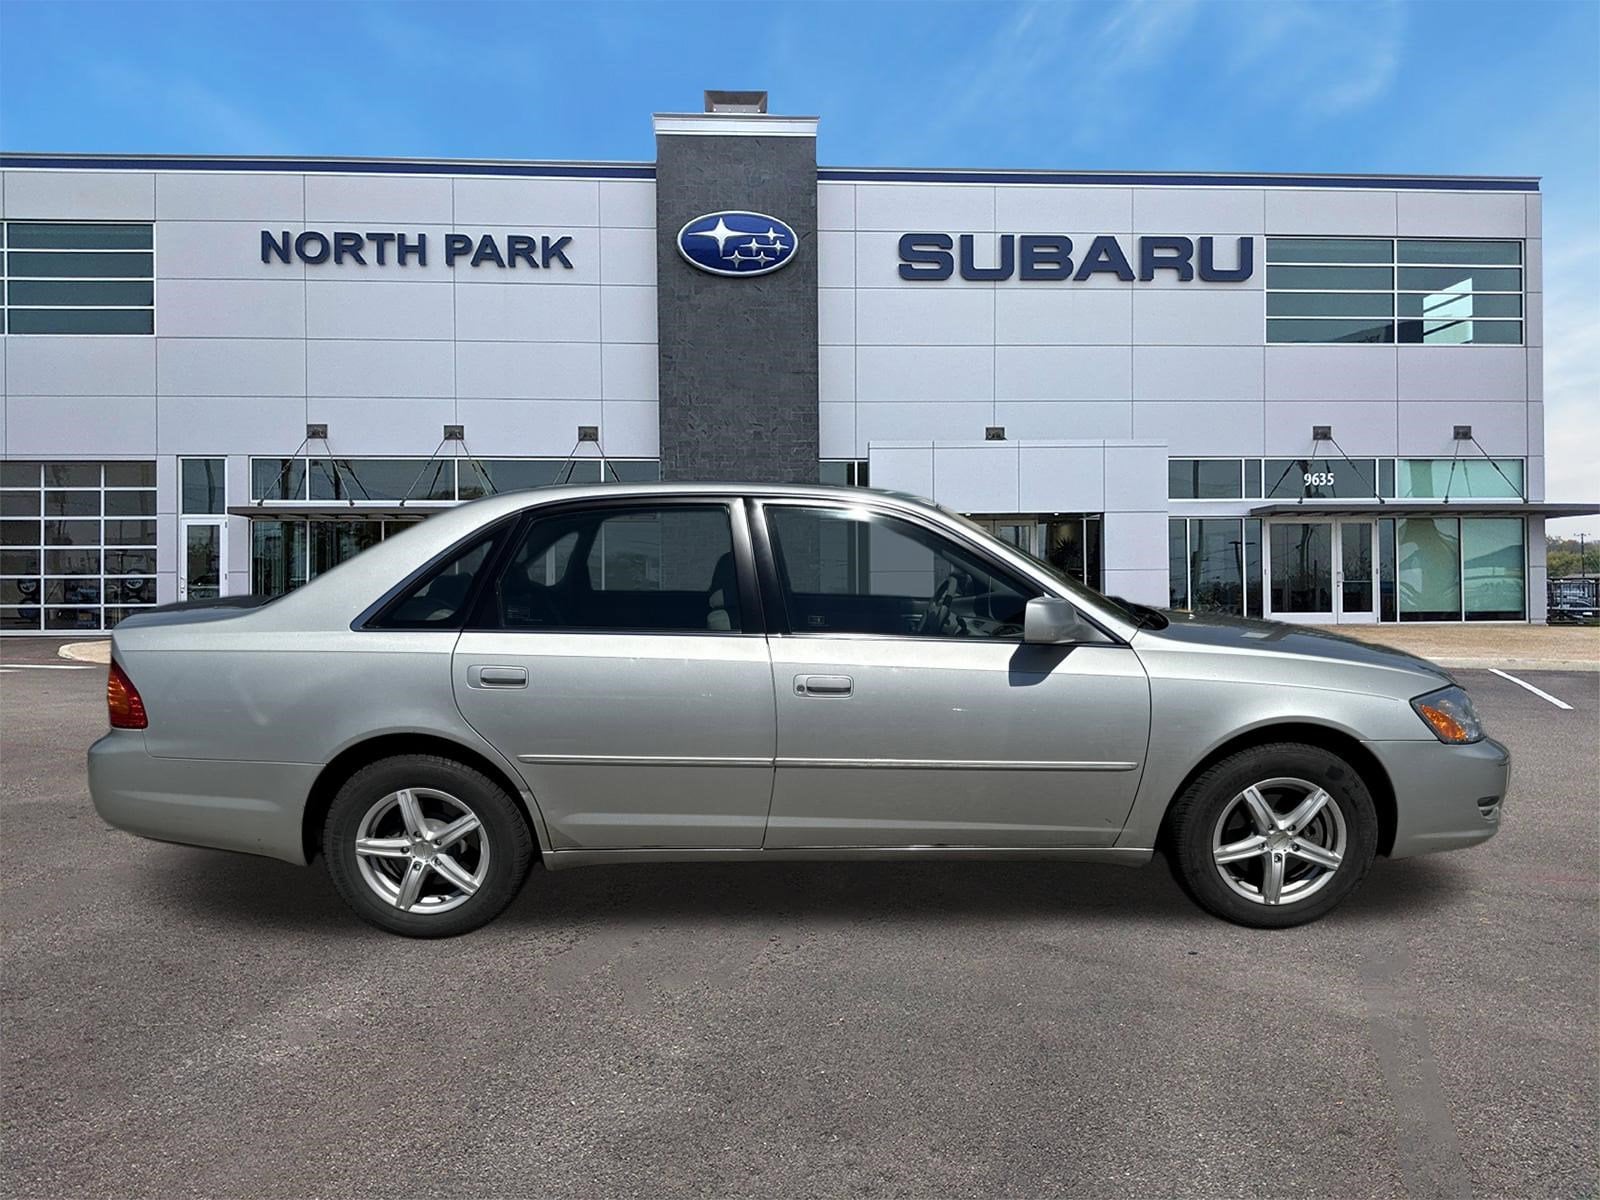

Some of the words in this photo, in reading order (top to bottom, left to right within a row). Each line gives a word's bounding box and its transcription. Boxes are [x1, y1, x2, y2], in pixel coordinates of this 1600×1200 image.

[261, 231, 427, 268] NORTH
[445, 233, 574, 270] PARK
[898, 232, 1254, 283] SUBARU
[1303, 472, 1335, 487] 9635
